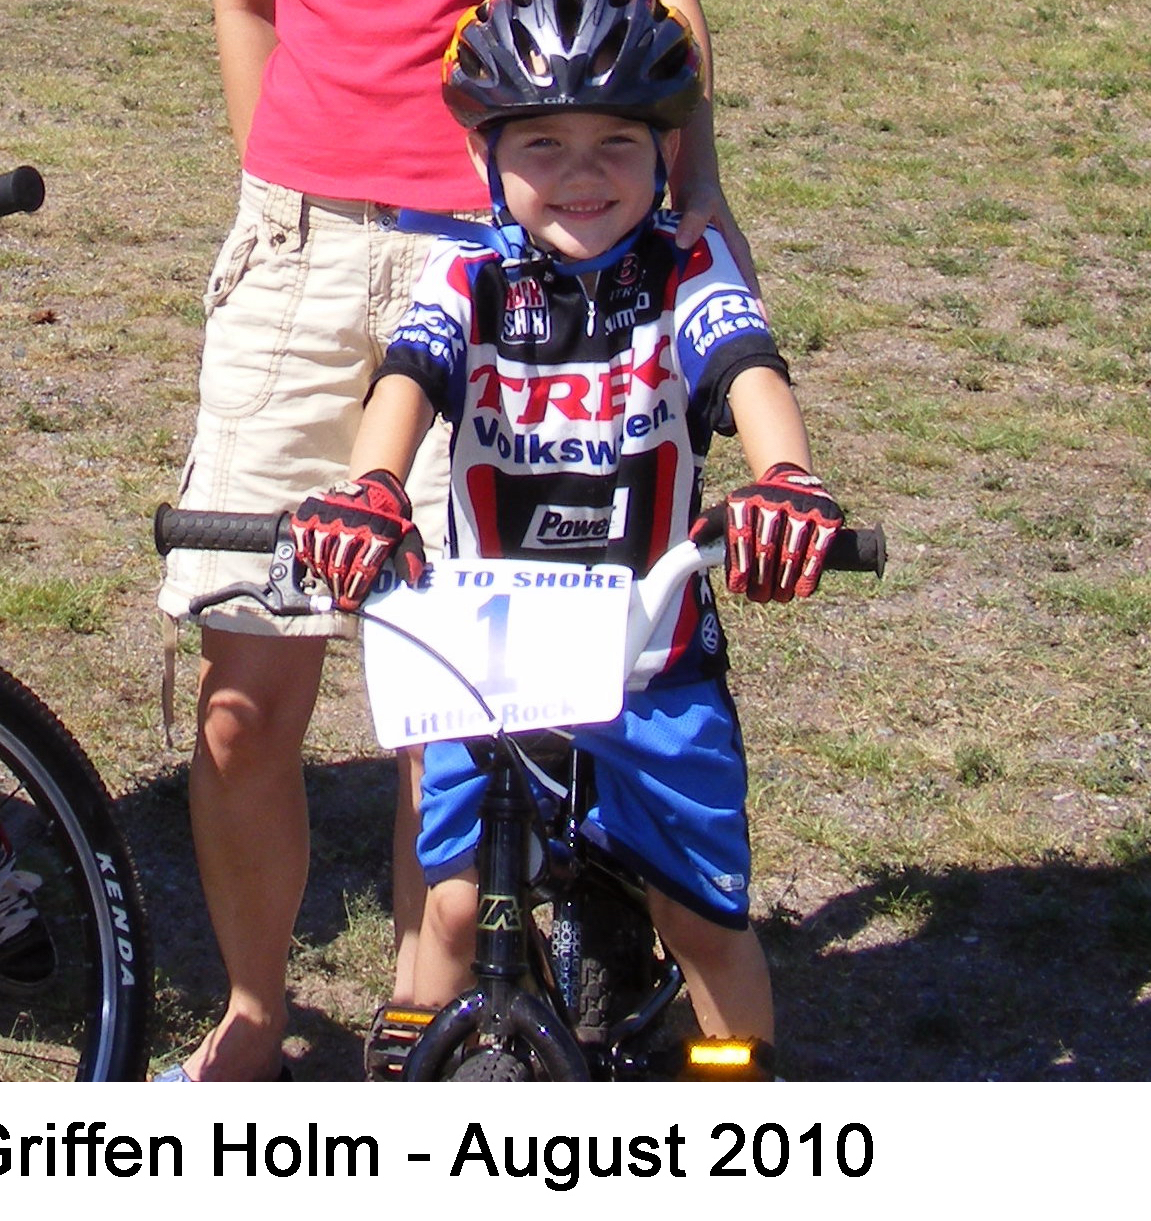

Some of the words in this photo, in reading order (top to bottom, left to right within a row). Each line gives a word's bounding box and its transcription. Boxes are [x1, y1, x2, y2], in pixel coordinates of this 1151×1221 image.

[469, 335, 671, 425] TREK
[454, 569, 496, 588] TO
[512, 570, 628, 589] SHORE
[475, 593, 519, 697] 1
[501, 697, 576, 725] Rock
[95, 851, 135, 986] KENDA
